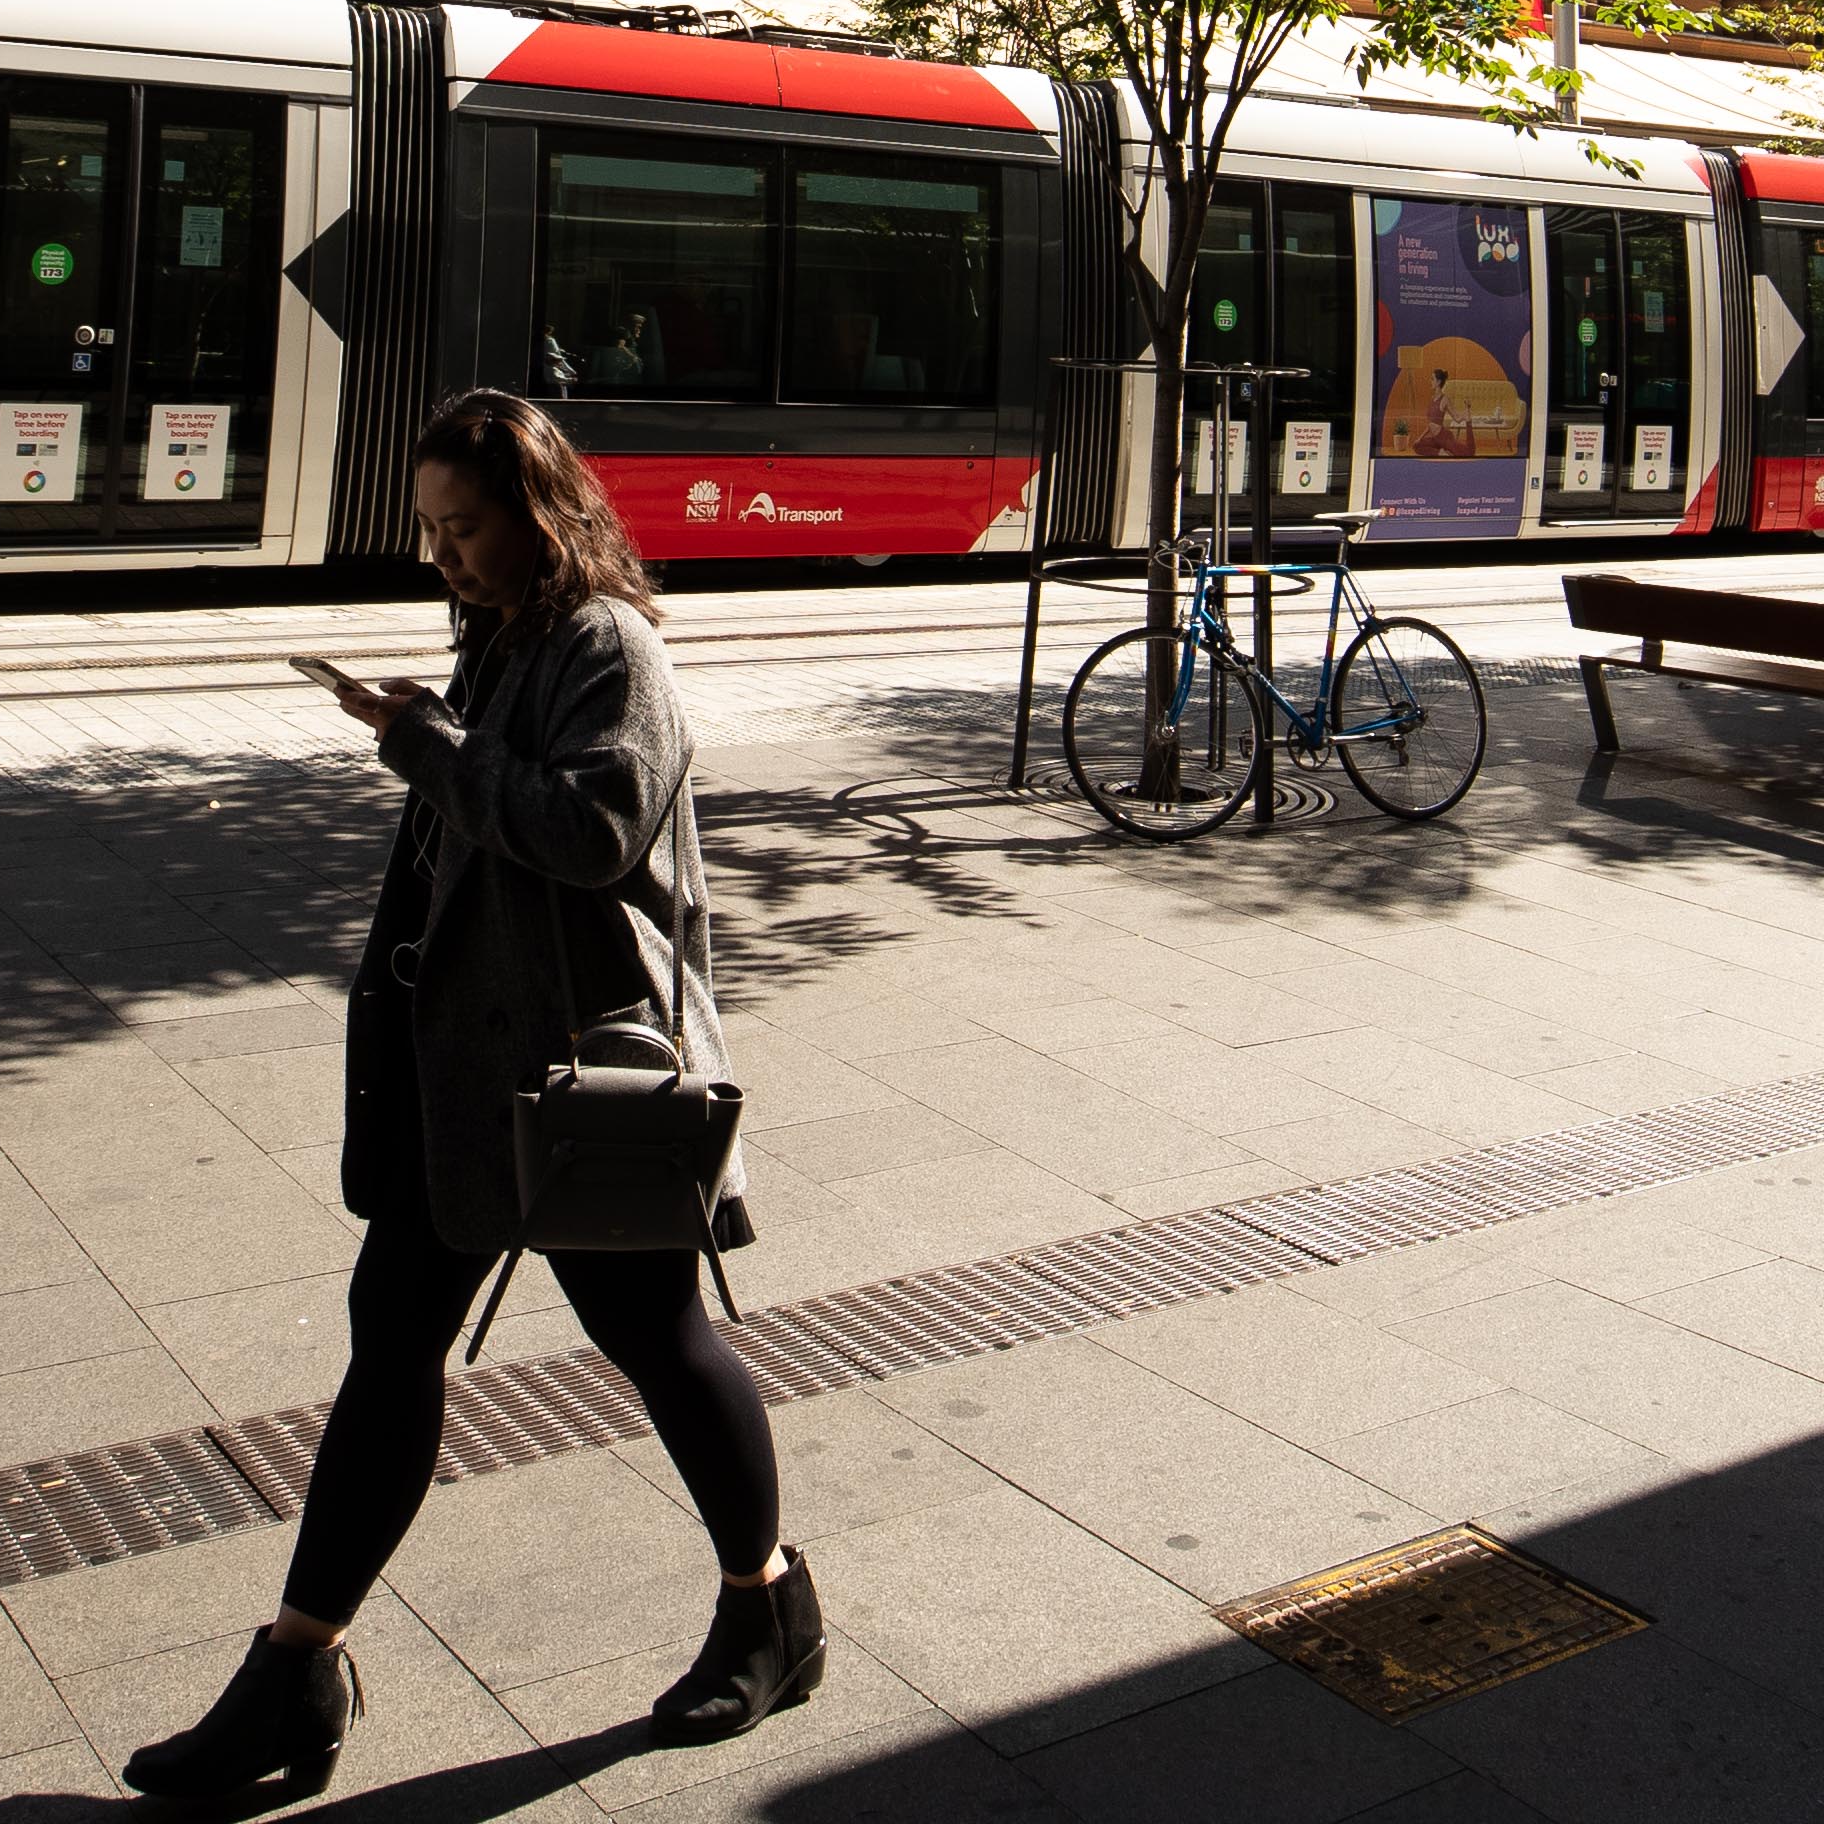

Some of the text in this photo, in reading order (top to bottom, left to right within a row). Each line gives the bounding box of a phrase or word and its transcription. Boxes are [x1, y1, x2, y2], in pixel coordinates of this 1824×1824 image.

[1478, 236, 1521, 264] pod
[43, 269, 63, 277] 173
[14, 411, 29, 419] Tap
[44, 412, 68, 420] every
[165, 412, 179, 420] Tap
[194, 413, 217, 421] every
[37, 420, 65, 428] before
[187, 421, 215, 429] before
[19, 430, 59, 438] boarding
[170, 430, 208, 439] boarding
[686, 504, 720, 517] NSW
[777, 506, 843, 524] Transport
